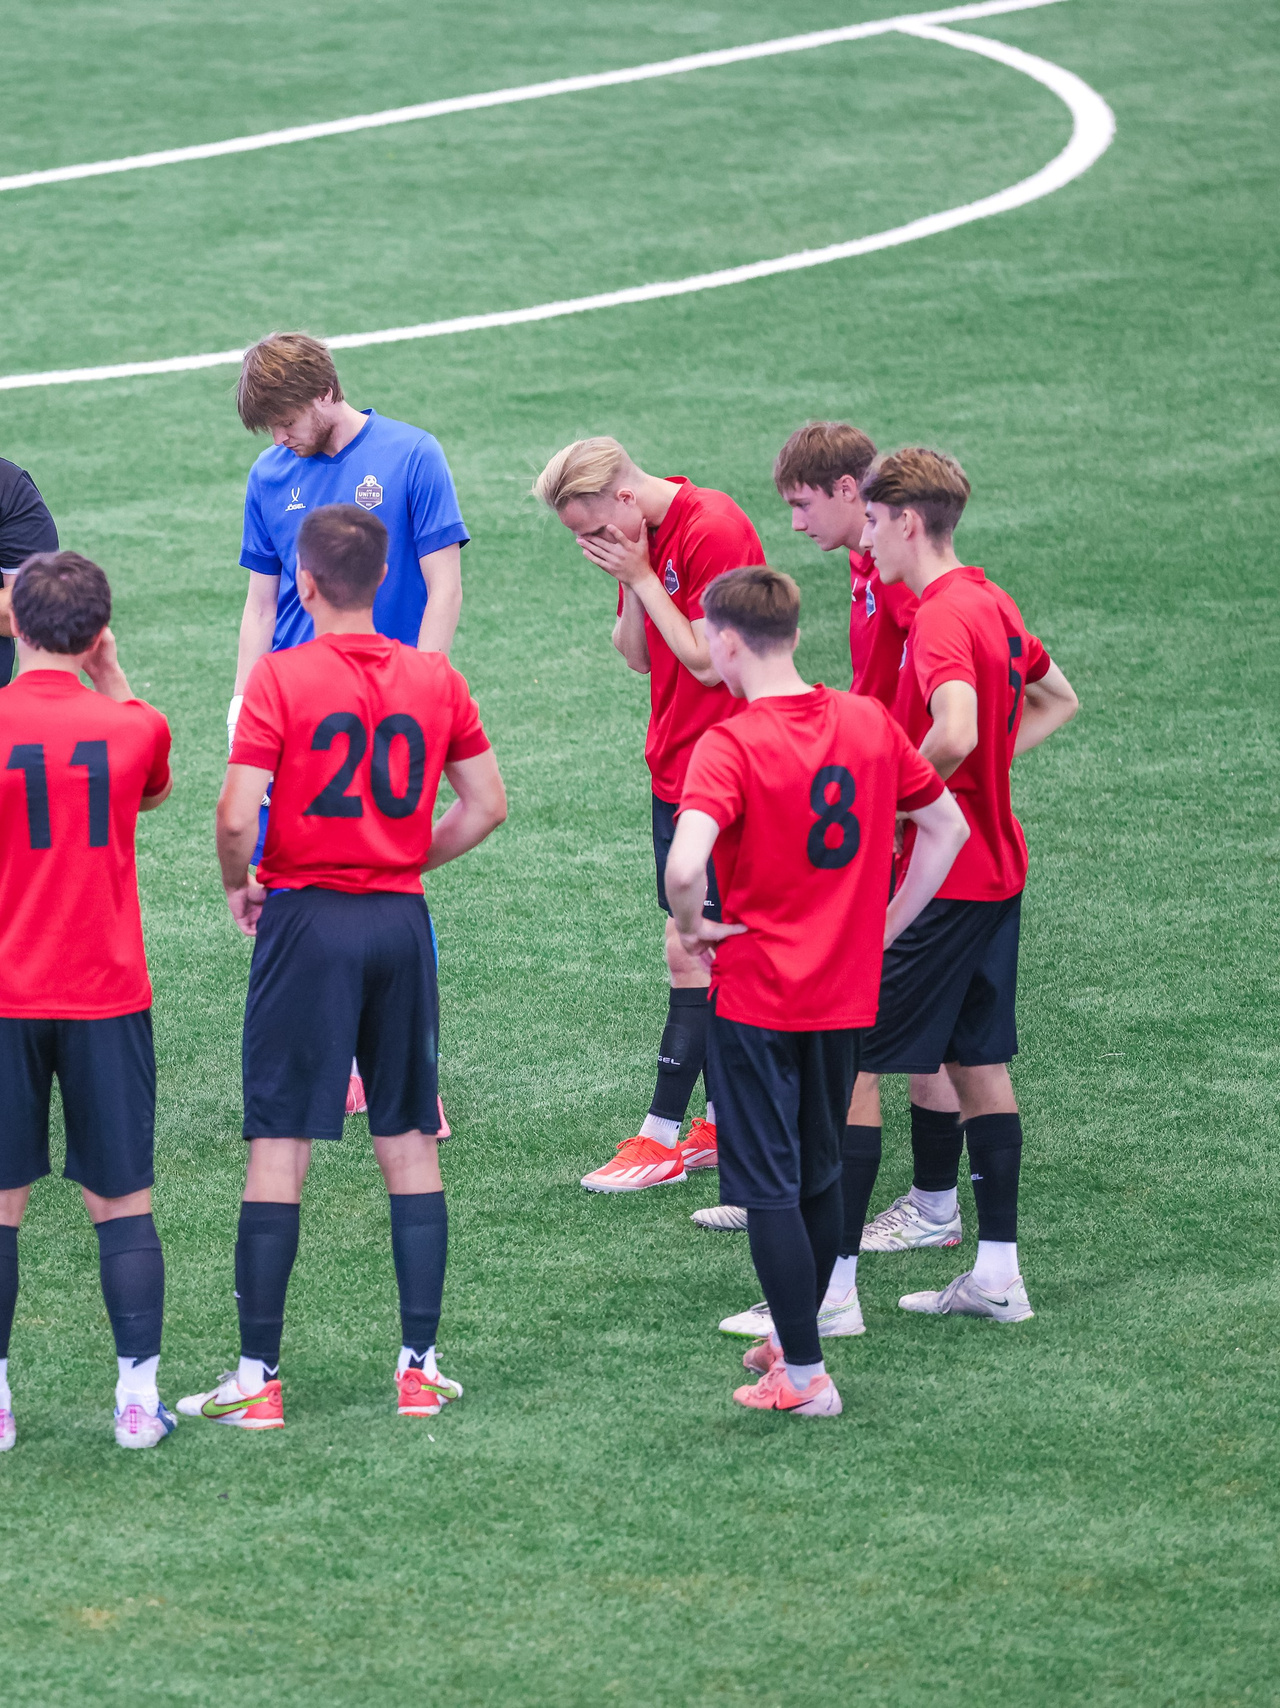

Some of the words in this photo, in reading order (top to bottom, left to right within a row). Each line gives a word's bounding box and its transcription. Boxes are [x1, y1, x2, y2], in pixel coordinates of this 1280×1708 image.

[5, 739, 110, 850] 11
[302, 711, 426, 820] 20
[805, 764, 862, 871] 8
[658, 1055, 681, 1066] GEL
